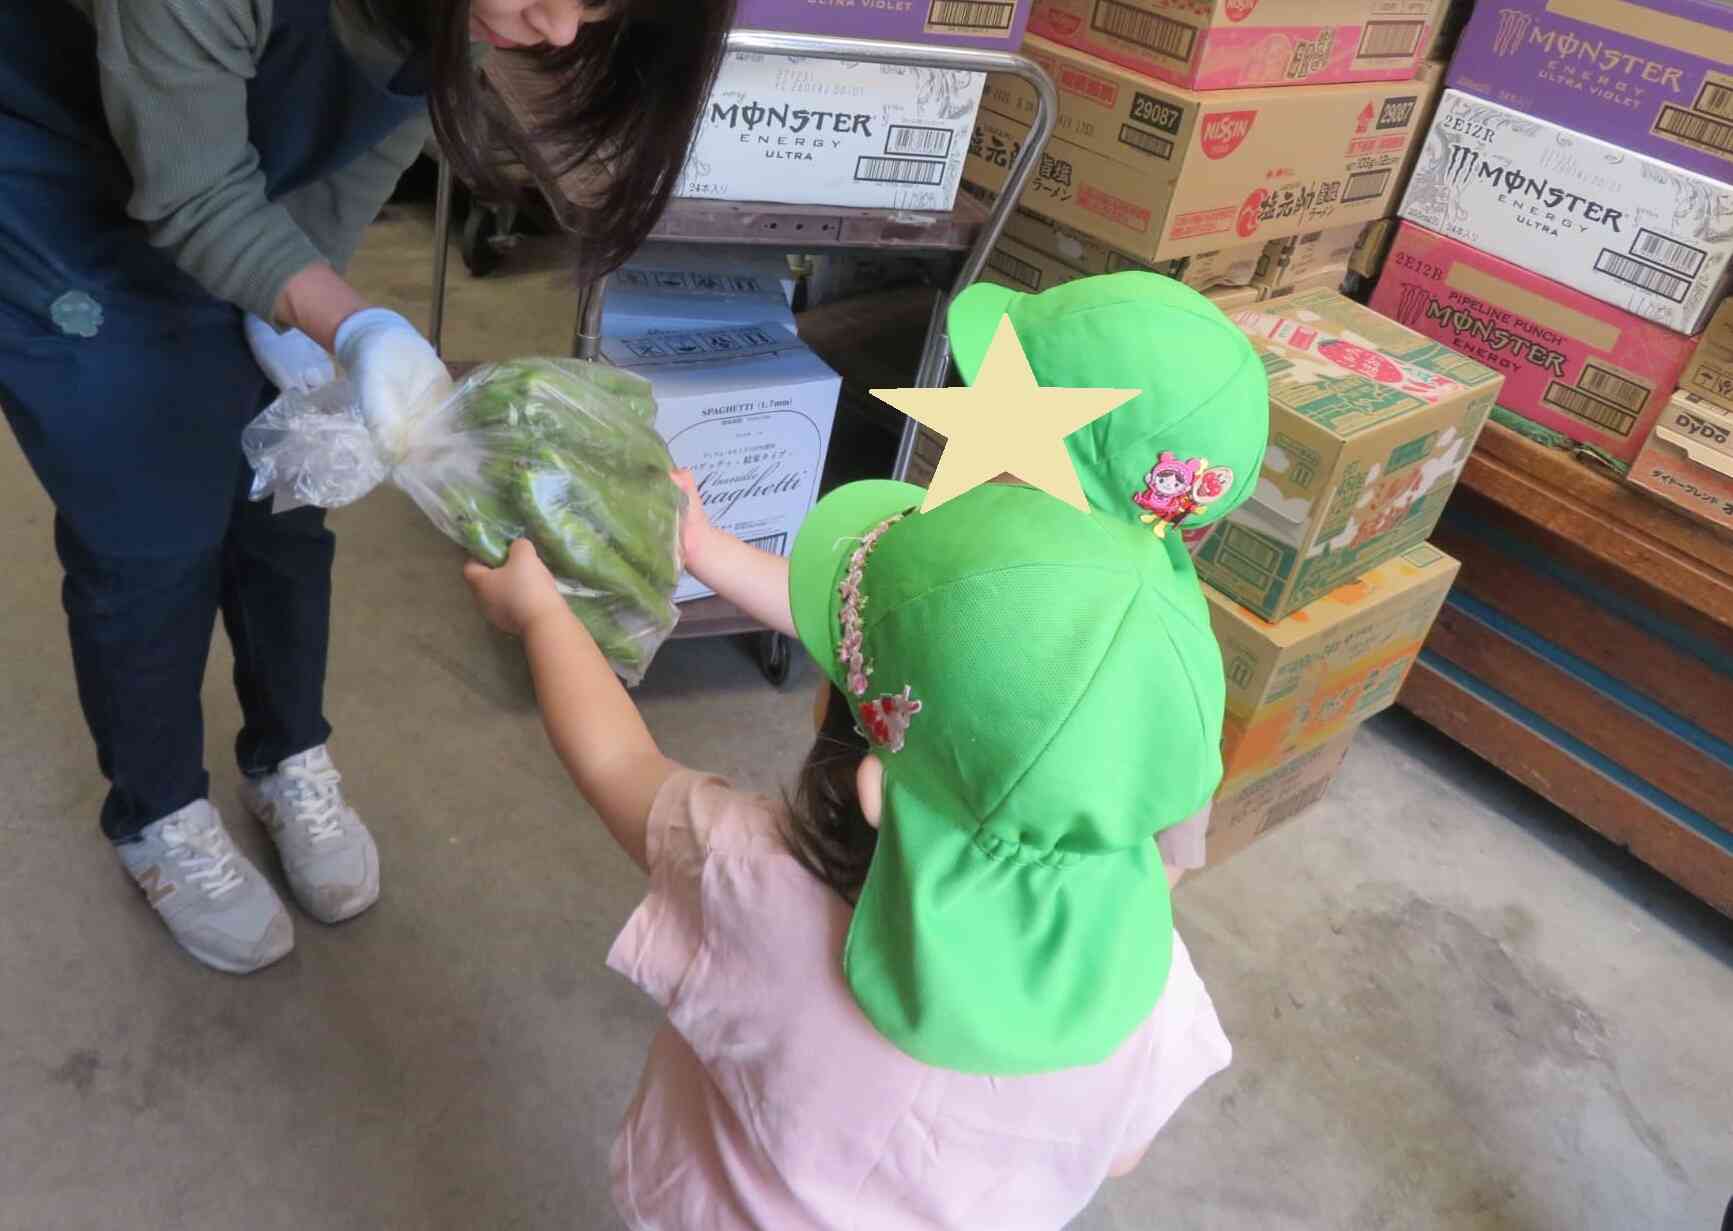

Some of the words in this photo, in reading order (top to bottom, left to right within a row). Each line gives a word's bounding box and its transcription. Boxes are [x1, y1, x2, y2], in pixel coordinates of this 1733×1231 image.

[1529, 25, 1684, 93] MONSTER
[1538, 70, 1584, 93] ULTRA
[1589, 84, 1642, 110] VIOLET
[1548, 60, 1646, 97] ENERGY
[710, 101, 872, 137] MONSTER
[1134, 98, 1180, 128] 29087
[1203, 117, 1249, 140] NISSIN
[740, 133, 841, 149] ENERGY
[765, 150, 813, 161] ULTRA
[1032, 178, 1073, 202] ラーメン
[1478, 160, 1624, 233] MONSTER
[1498, 194, 1589, 234] ENERGY
[1516, 214, 1559, 237] ULTRA
[1448, 290, 1512, 326] PIPELINE
[1513, 315, 1564, 346] PUNCH
[1425, 297, 1568, 378] MONSTER
[1453, 337, 1522, 372] ENERGY
[701, 401, 754, 417] SPAGHETTI
[1675, 414, 1727, 445] DyDo
